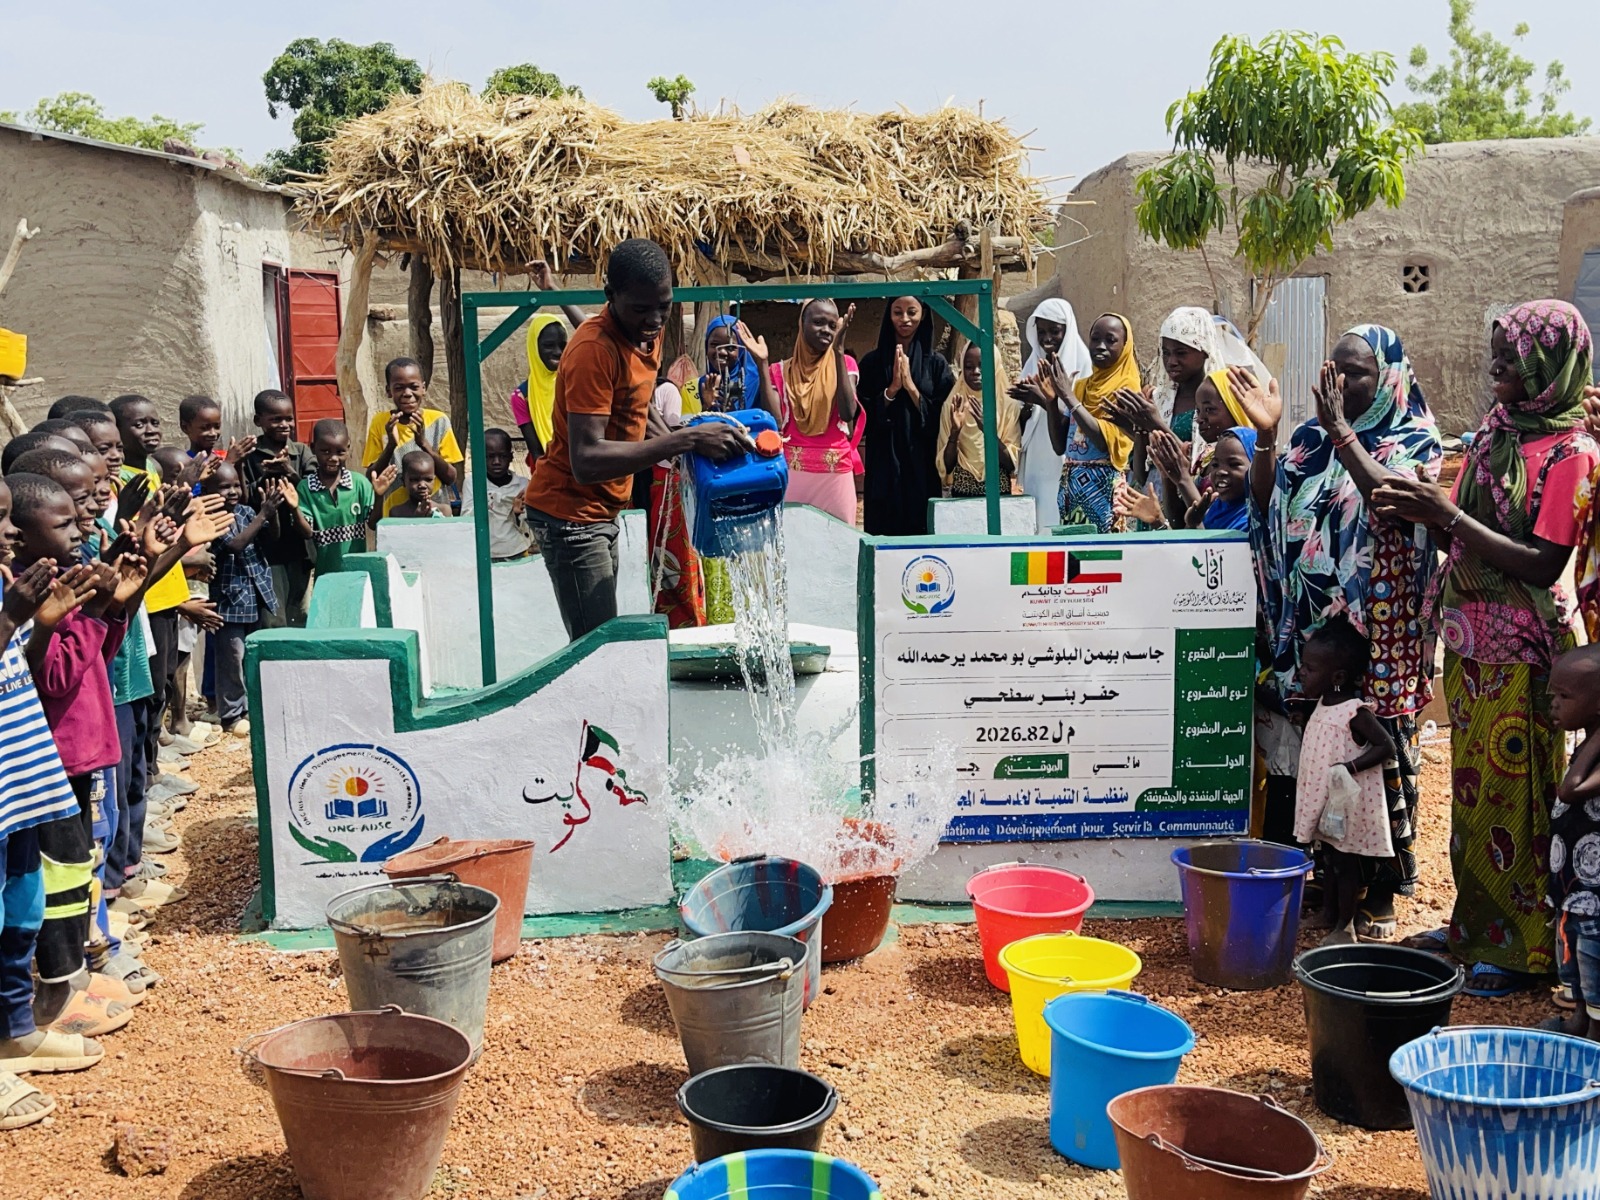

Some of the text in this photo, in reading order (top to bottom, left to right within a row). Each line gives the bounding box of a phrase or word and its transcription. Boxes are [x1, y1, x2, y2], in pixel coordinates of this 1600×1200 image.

[1021, 585, 1108, 598] الكويت بجانبكم
[897, 647, 919, 663] الله
[970, 651, 1008, 663] محمد
[1010, 651, 1025, 666] بو
[1028, 646, 1082, 668] البلوشي
[1084, 648, 1119, 665] بهمن
[1123, 646, 1165, 664] جاسم
[1217, 646, 1249, 662] اسم
[1037, 688, 1076, 706] بئر
[1079, 685, 1120, 704] حفر
[1229, 685, 1248, 701] نوع
[1221, 721, 1246, 737] رقم
[977, 824, 990, 836] de
[1081, 821, 1105, 837] pour
[1112, 821, 1142, 833] Servir
